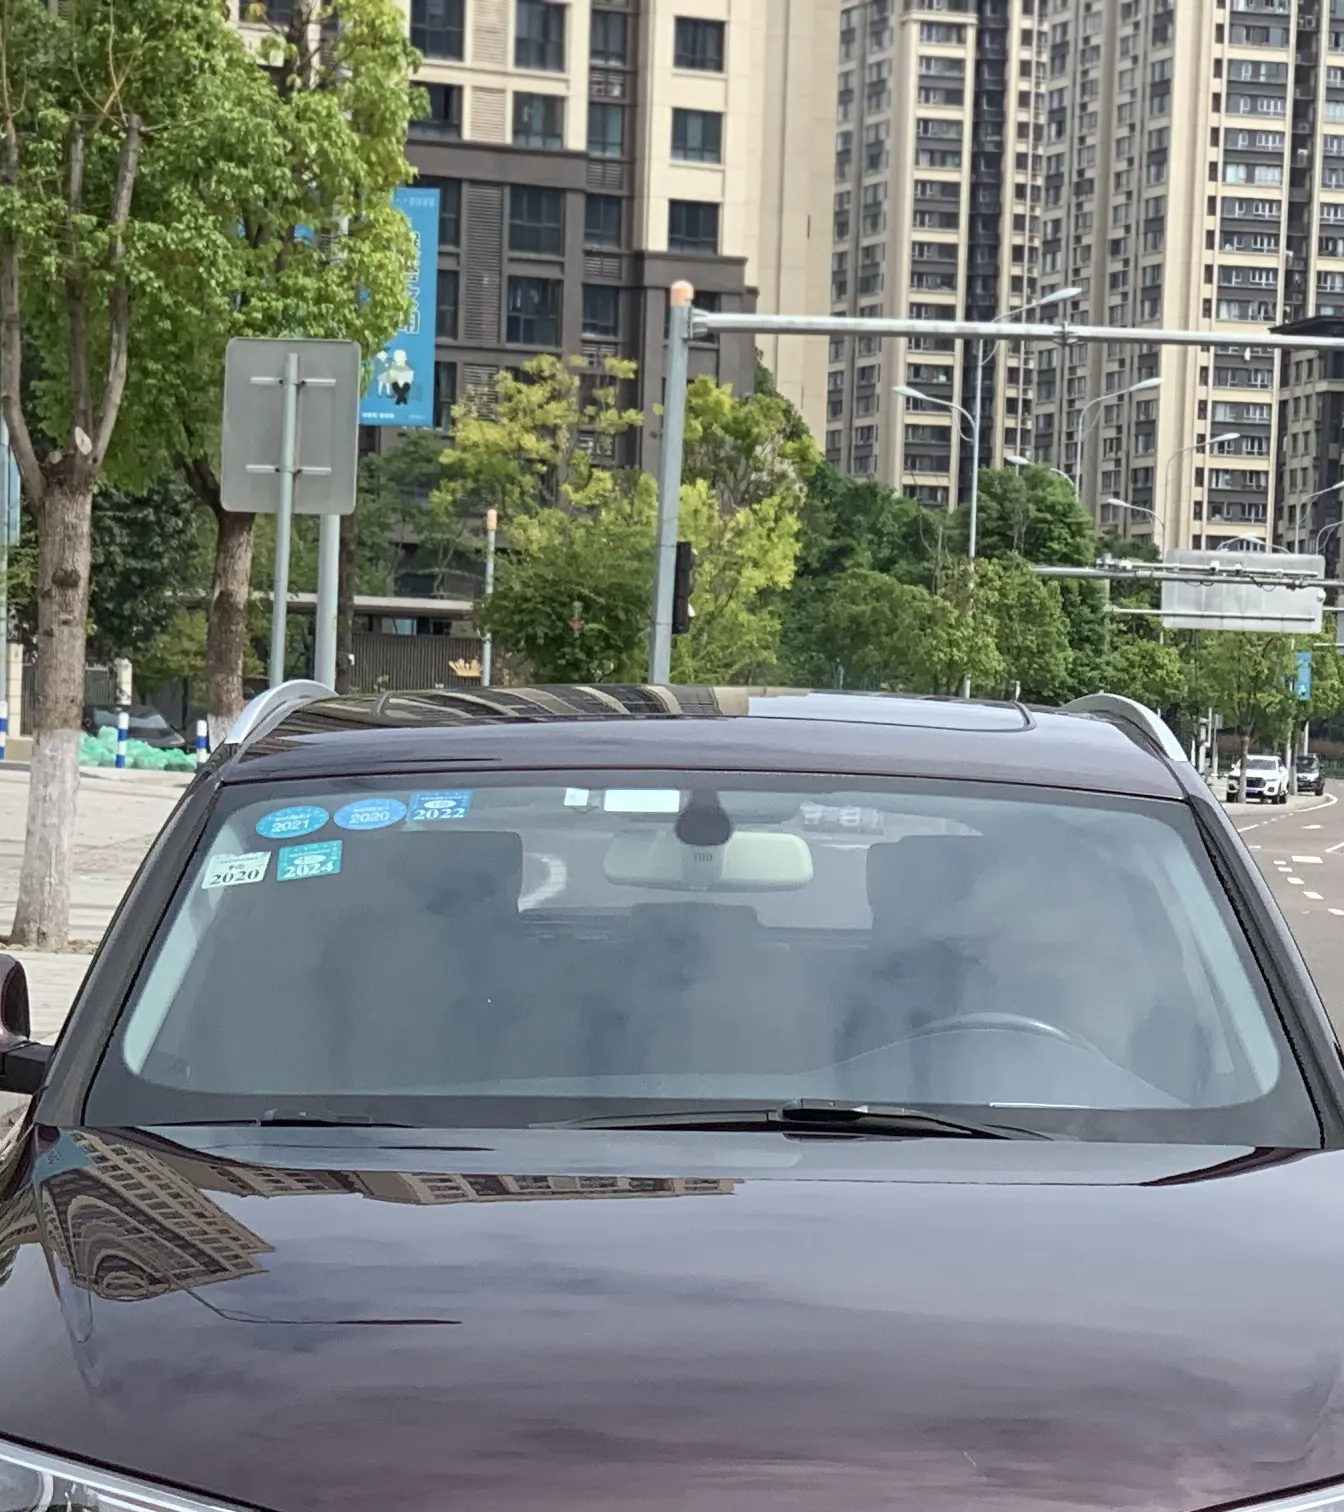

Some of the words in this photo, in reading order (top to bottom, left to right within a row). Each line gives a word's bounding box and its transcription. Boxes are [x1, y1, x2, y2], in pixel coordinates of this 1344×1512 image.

[348, 810, 391, 824] 2020
[413, 807, 465, 820] 2022
[271, 818, 311, 833] 2021
[208, 868, 260, 885] 2020
[282, 860, 335, 879] 2024
